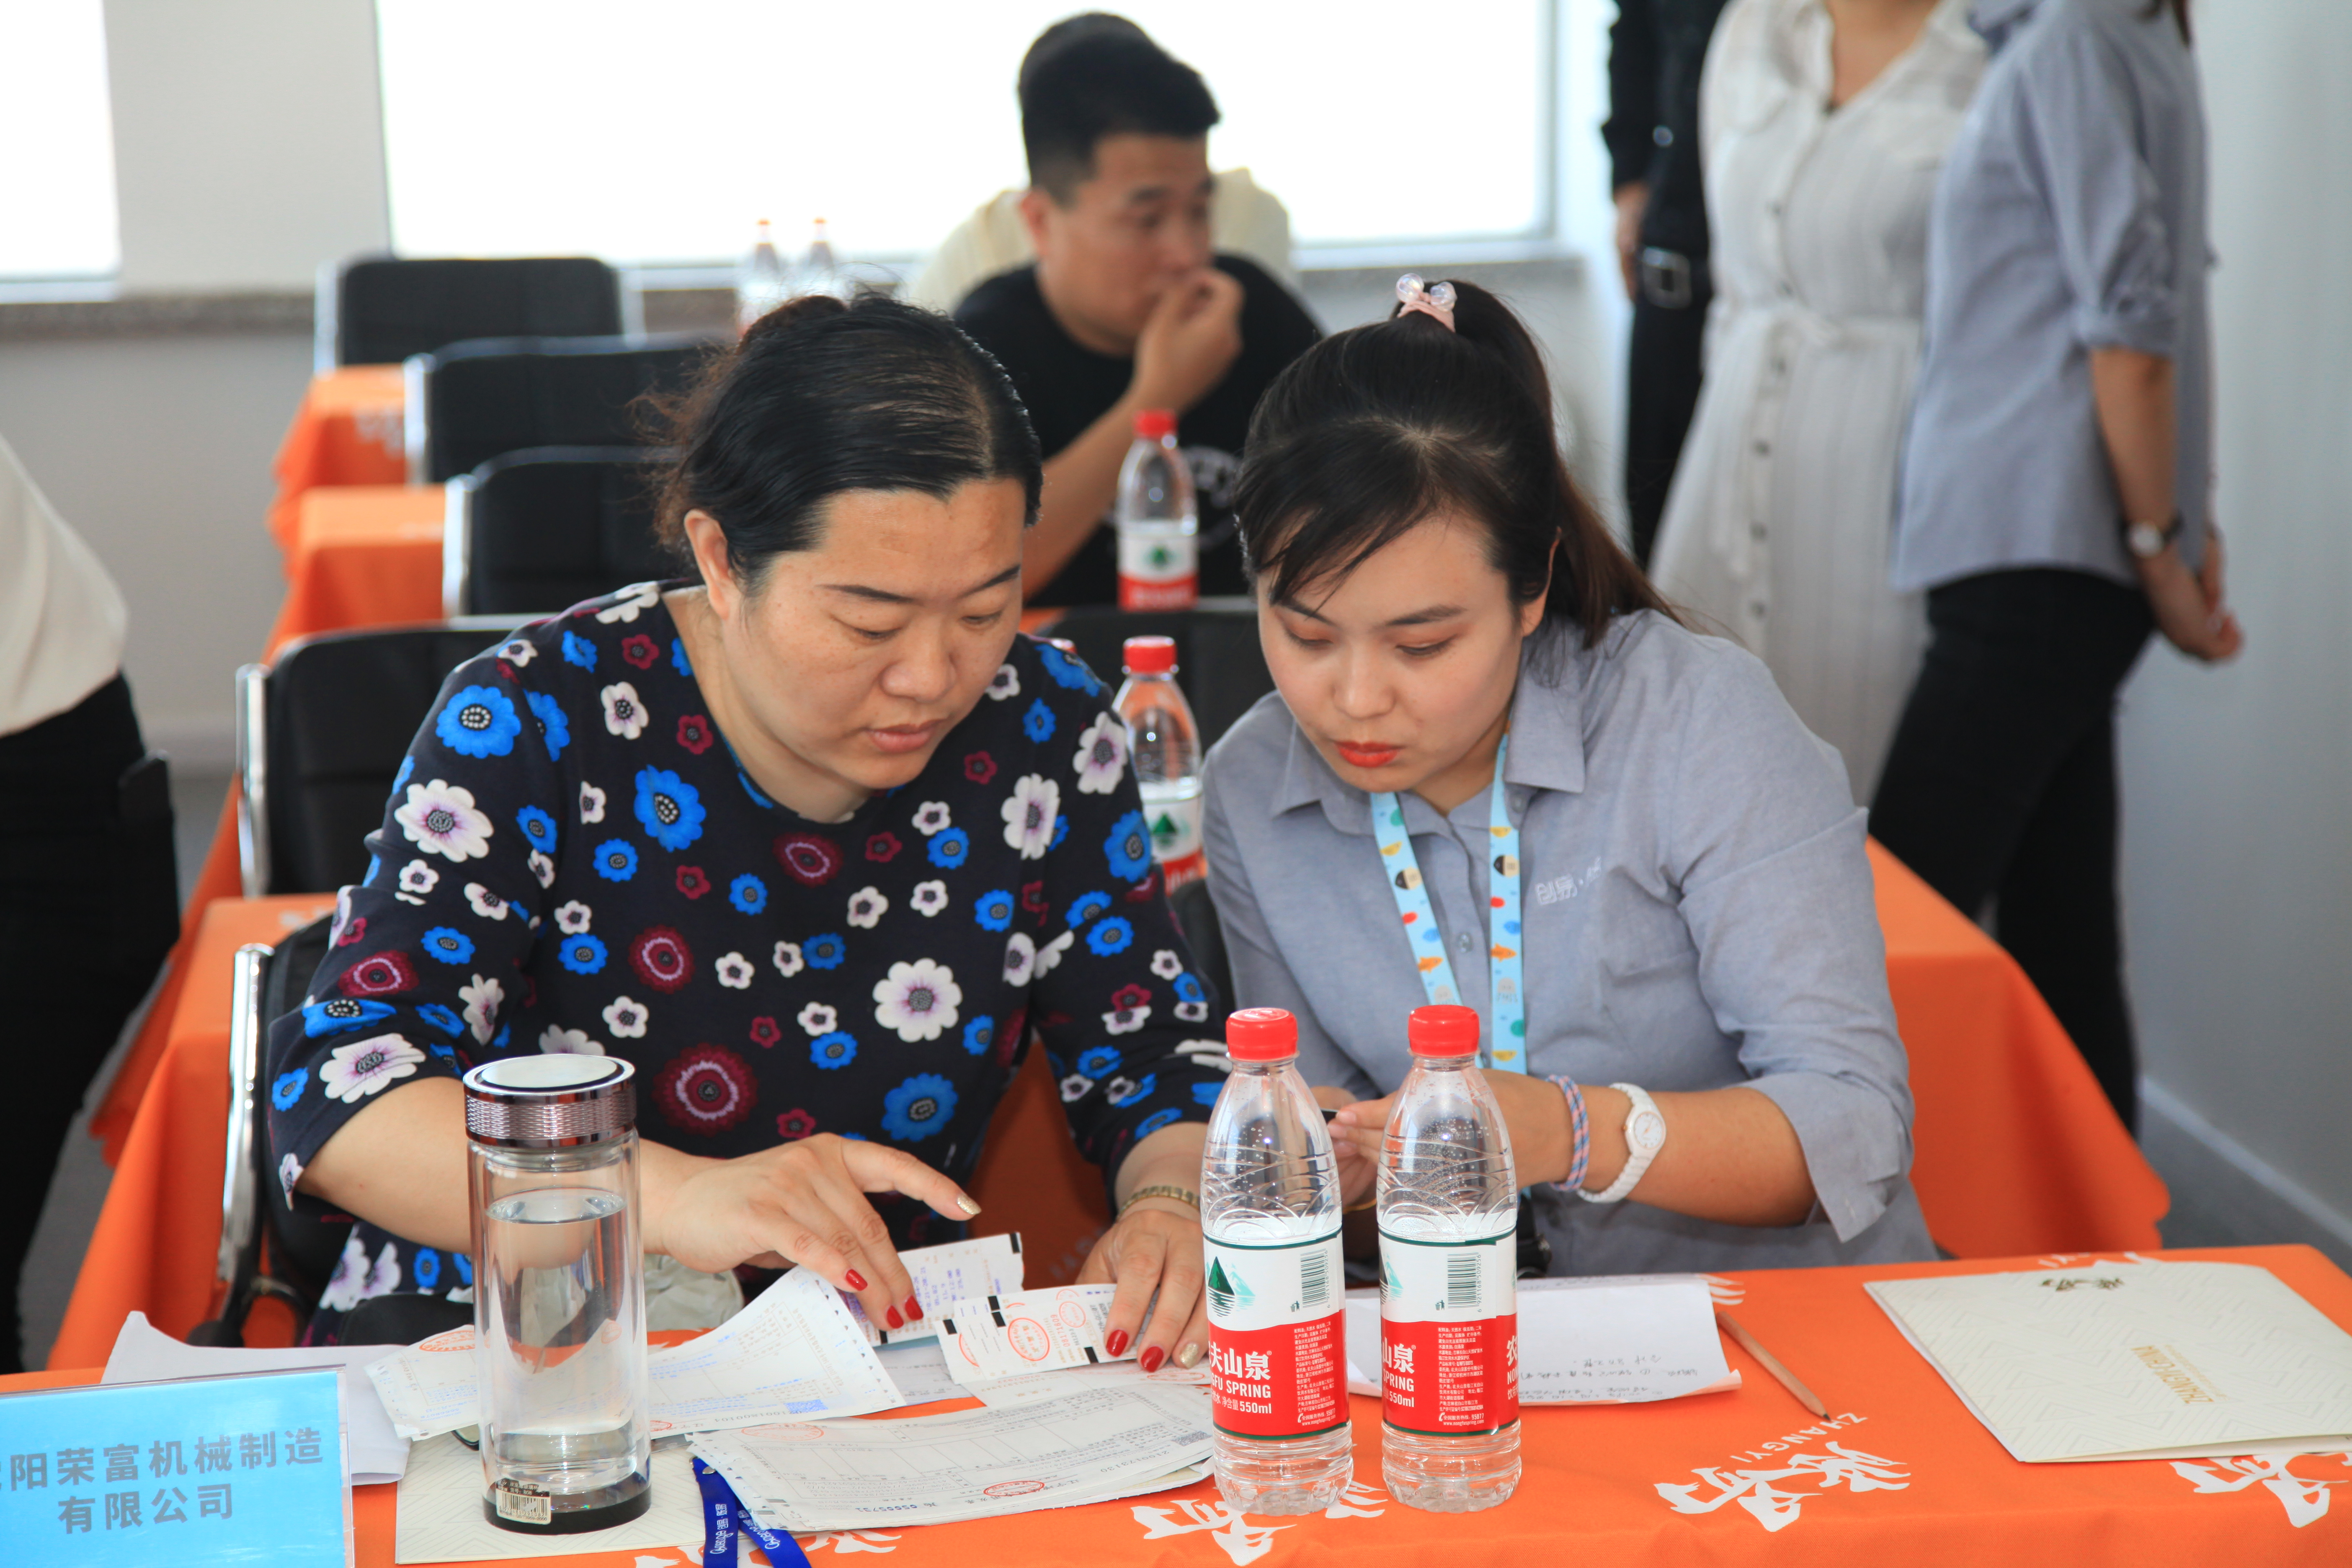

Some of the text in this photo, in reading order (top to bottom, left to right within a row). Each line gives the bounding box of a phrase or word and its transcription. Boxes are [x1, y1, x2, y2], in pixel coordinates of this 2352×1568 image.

[1209, 1341, 1271, 1380] 夫山泉
[1383, 1369, 1414, 1392] SPRING
[1226, 1380, 1271, 1398] SPRING
[0, 1427, 323, 1491] 阳荣富机械制造
[1730, 1412, 1867, 1463] ZHANGYI
[58, 1483, 232, 1534] 有限公司
